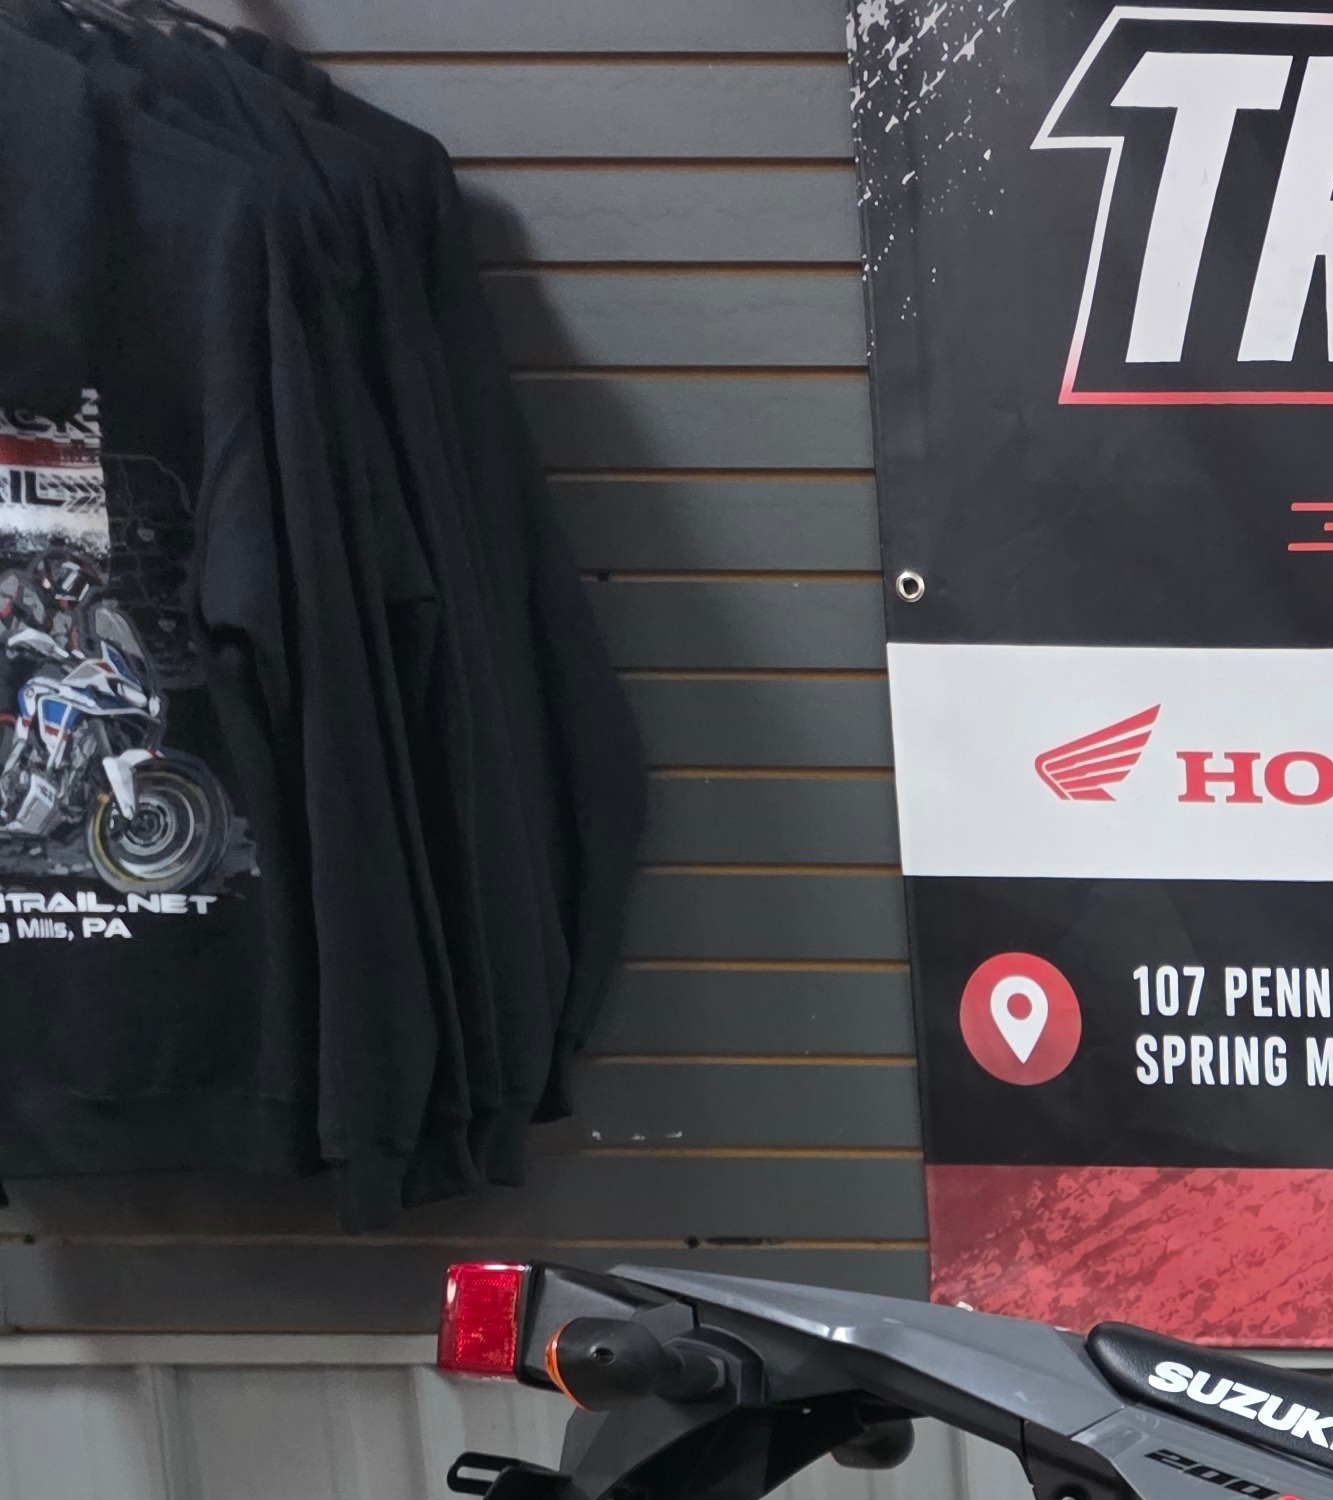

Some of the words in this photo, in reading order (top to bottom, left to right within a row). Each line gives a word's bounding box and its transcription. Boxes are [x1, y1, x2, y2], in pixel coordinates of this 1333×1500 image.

[15, 917, 75, 942] Mills,
[82, 916, 133, 939] PA
[1133, 965, 1206, 1017] 107
[1224, 966, 1332, 1019] PENN
[1135, 1034, 1288, 1087] SPRING
